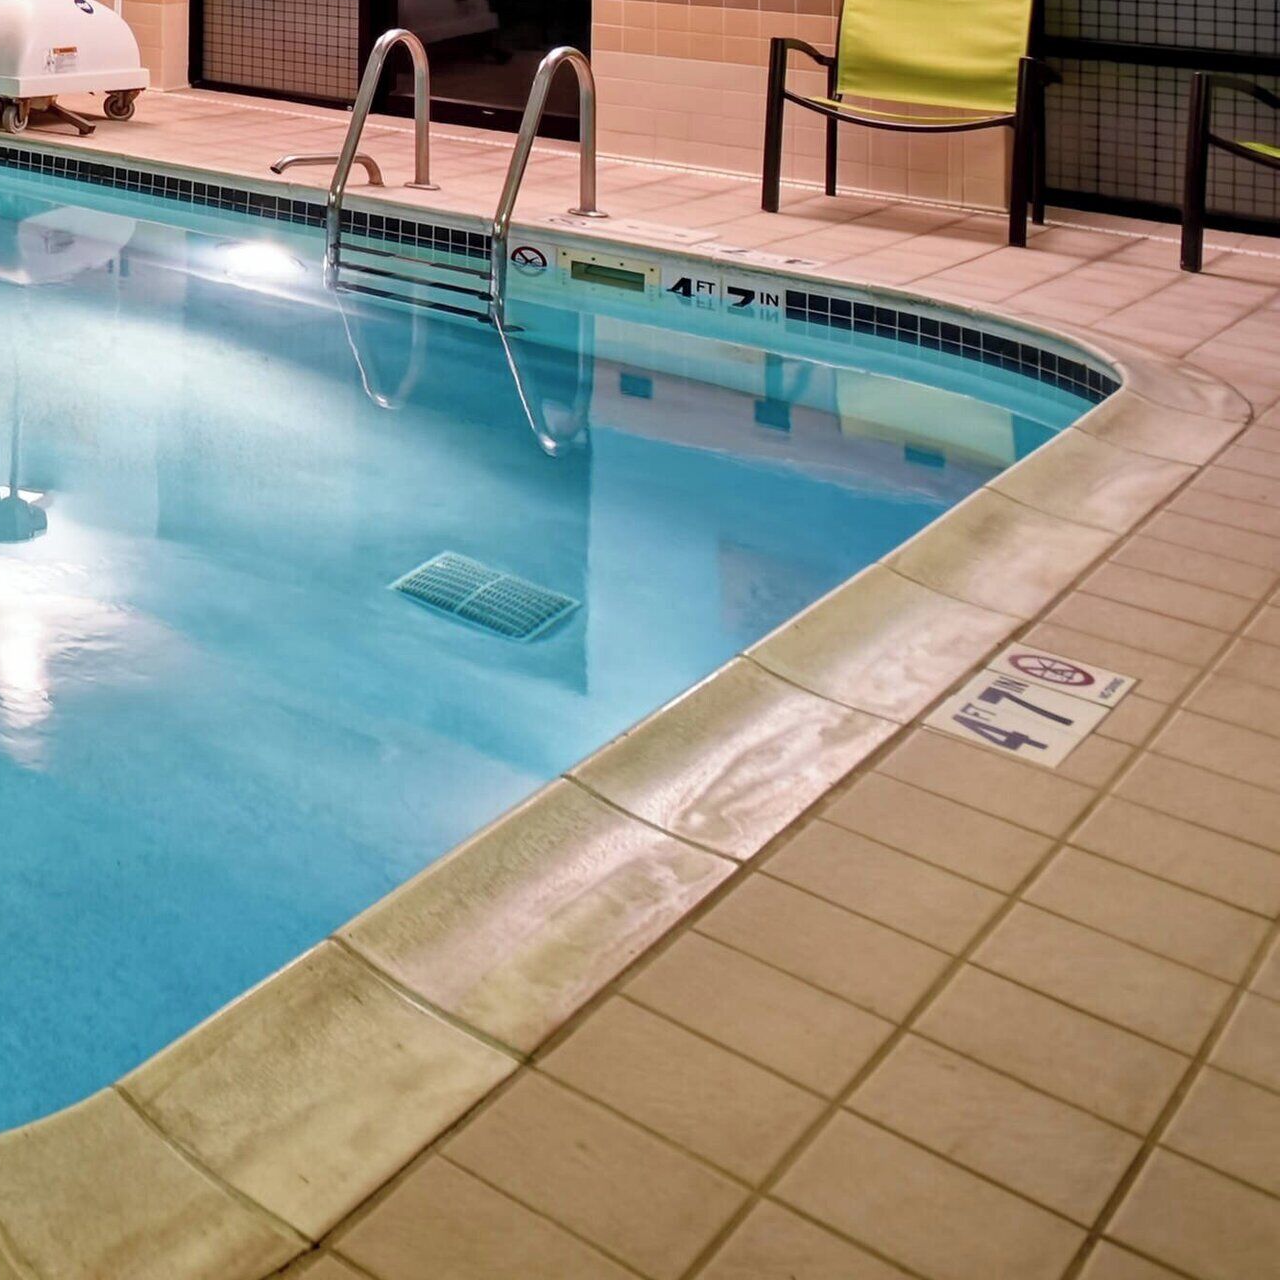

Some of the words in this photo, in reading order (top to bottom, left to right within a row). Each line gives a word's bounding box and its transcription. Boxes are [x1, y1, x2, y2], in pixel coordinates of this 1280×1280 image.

[697, 282, 715, 294] FT
[760, 292, 778, 306] IN
[978, 687, 1074, 726] 7
[952, 714, 1048, 750] 4
